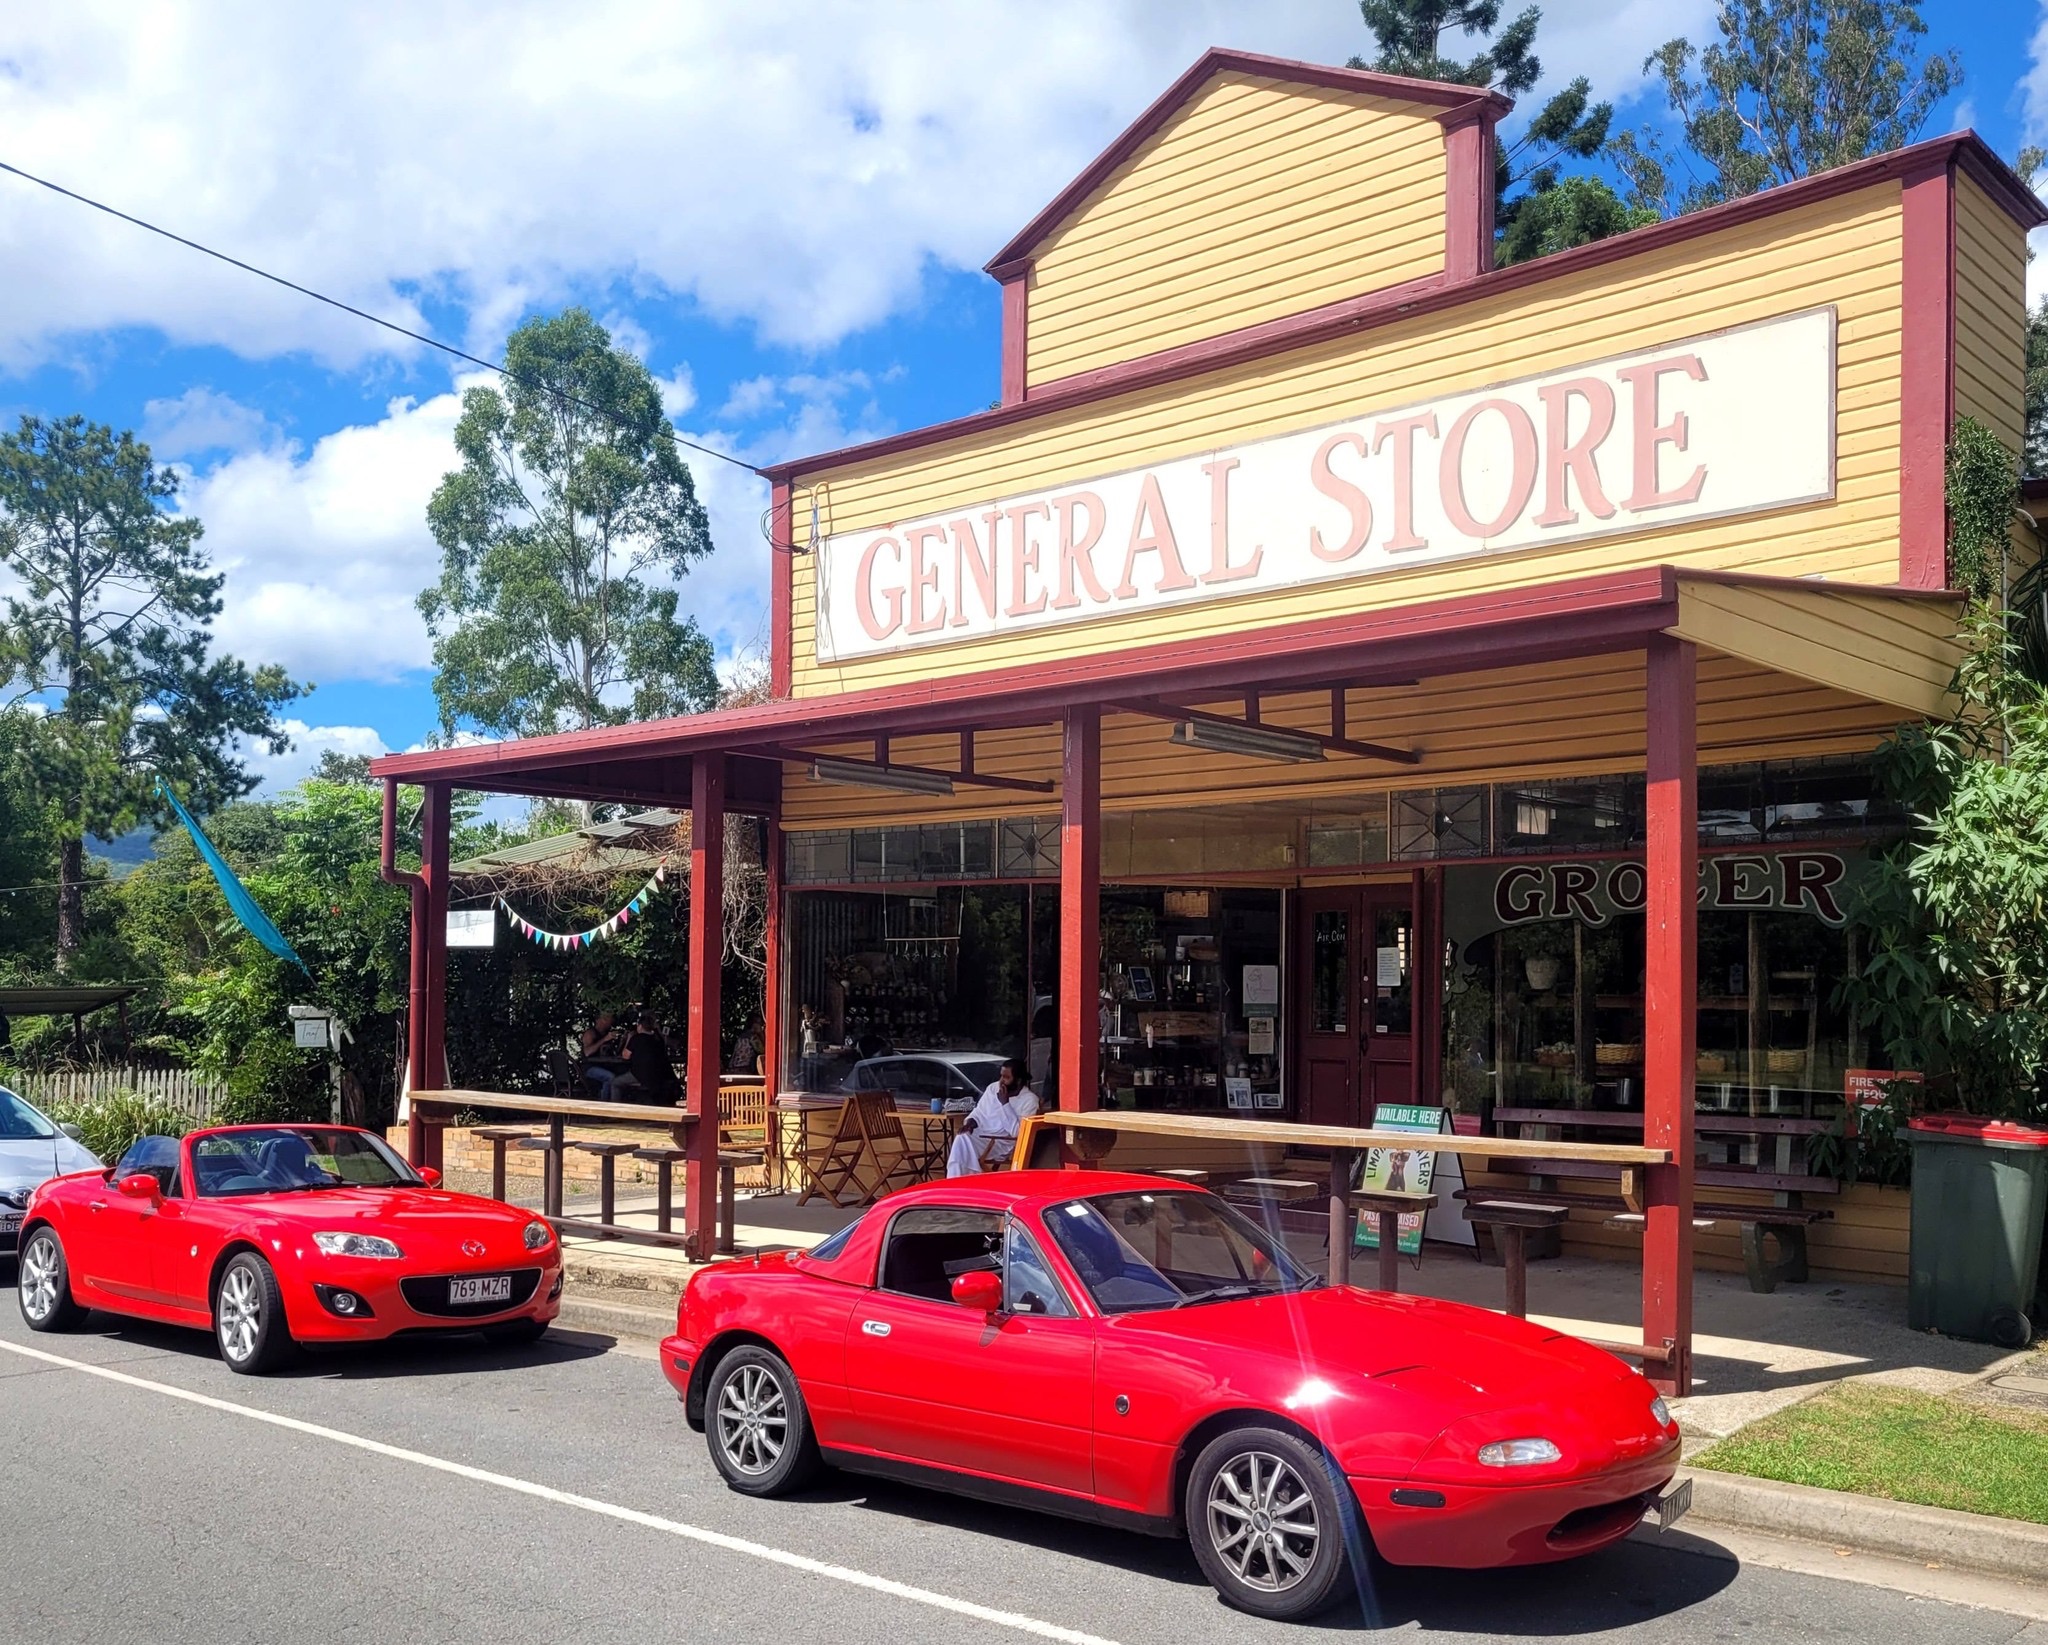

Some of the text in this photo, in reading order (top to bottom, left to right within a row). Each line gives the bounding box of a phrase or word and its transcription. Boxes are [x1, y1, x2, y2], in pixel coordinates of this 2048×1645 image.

[855, 353, 1709, 641] GENERAL STORE
[1495, 853, 1846, 929] GROER
[1849, 1077, 1875, 1087] FIRE
[1375, 1108, 1441, 1125] AVAILABLE HERE
